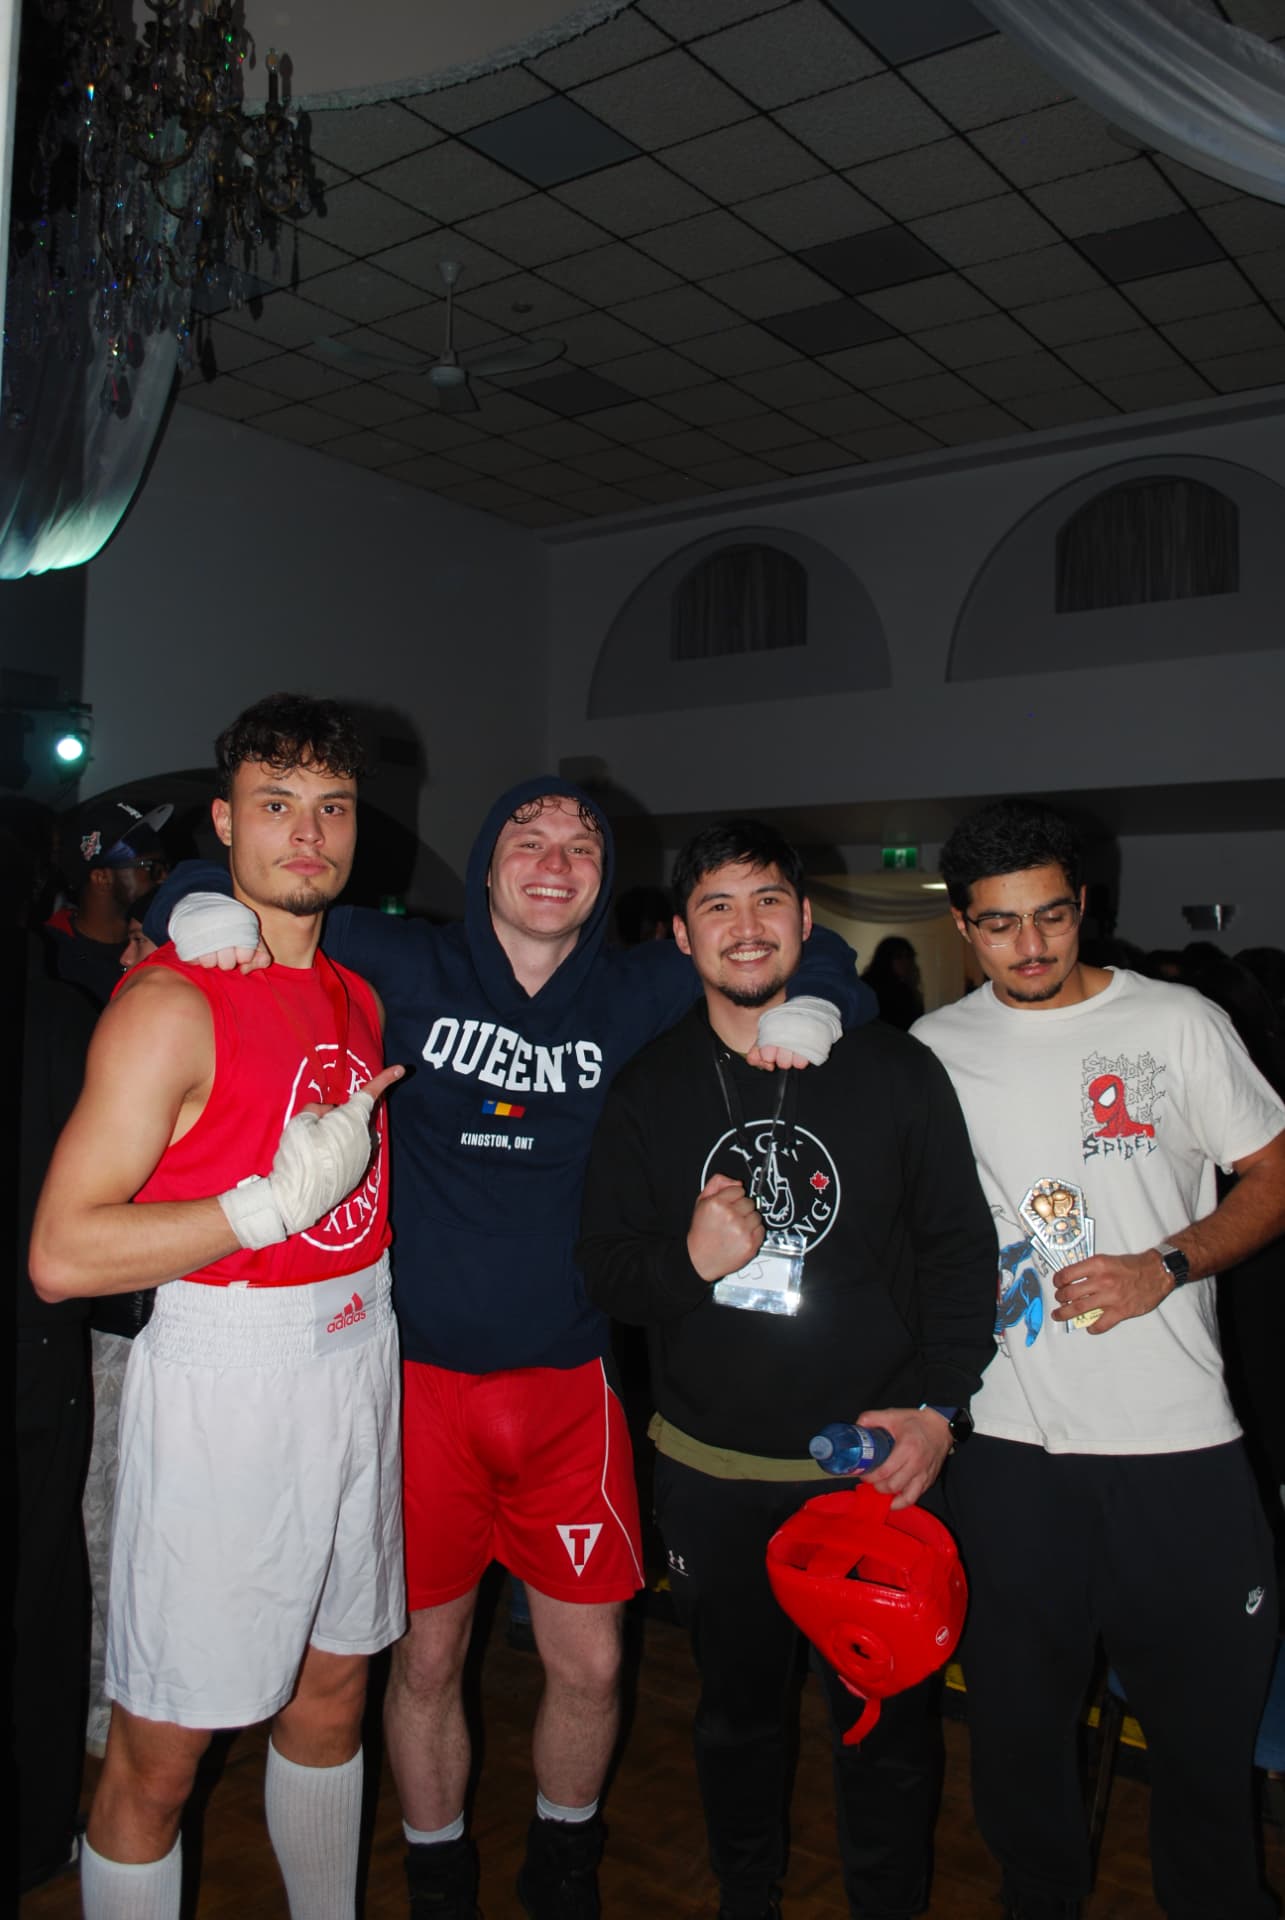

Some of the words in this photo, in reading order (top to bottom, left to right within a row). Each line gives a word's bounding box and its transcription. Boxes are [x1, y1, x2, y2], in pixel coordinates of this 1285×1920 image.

[422, 1017, 603, 1093] QUEEN'S
[460, 1132, 512, 1150] KINGSTON,
[514, 1136, 535, 1150] ONT
[326, 1311, 366, 1334] adidas
[568, 1528, 591, 1566] T
